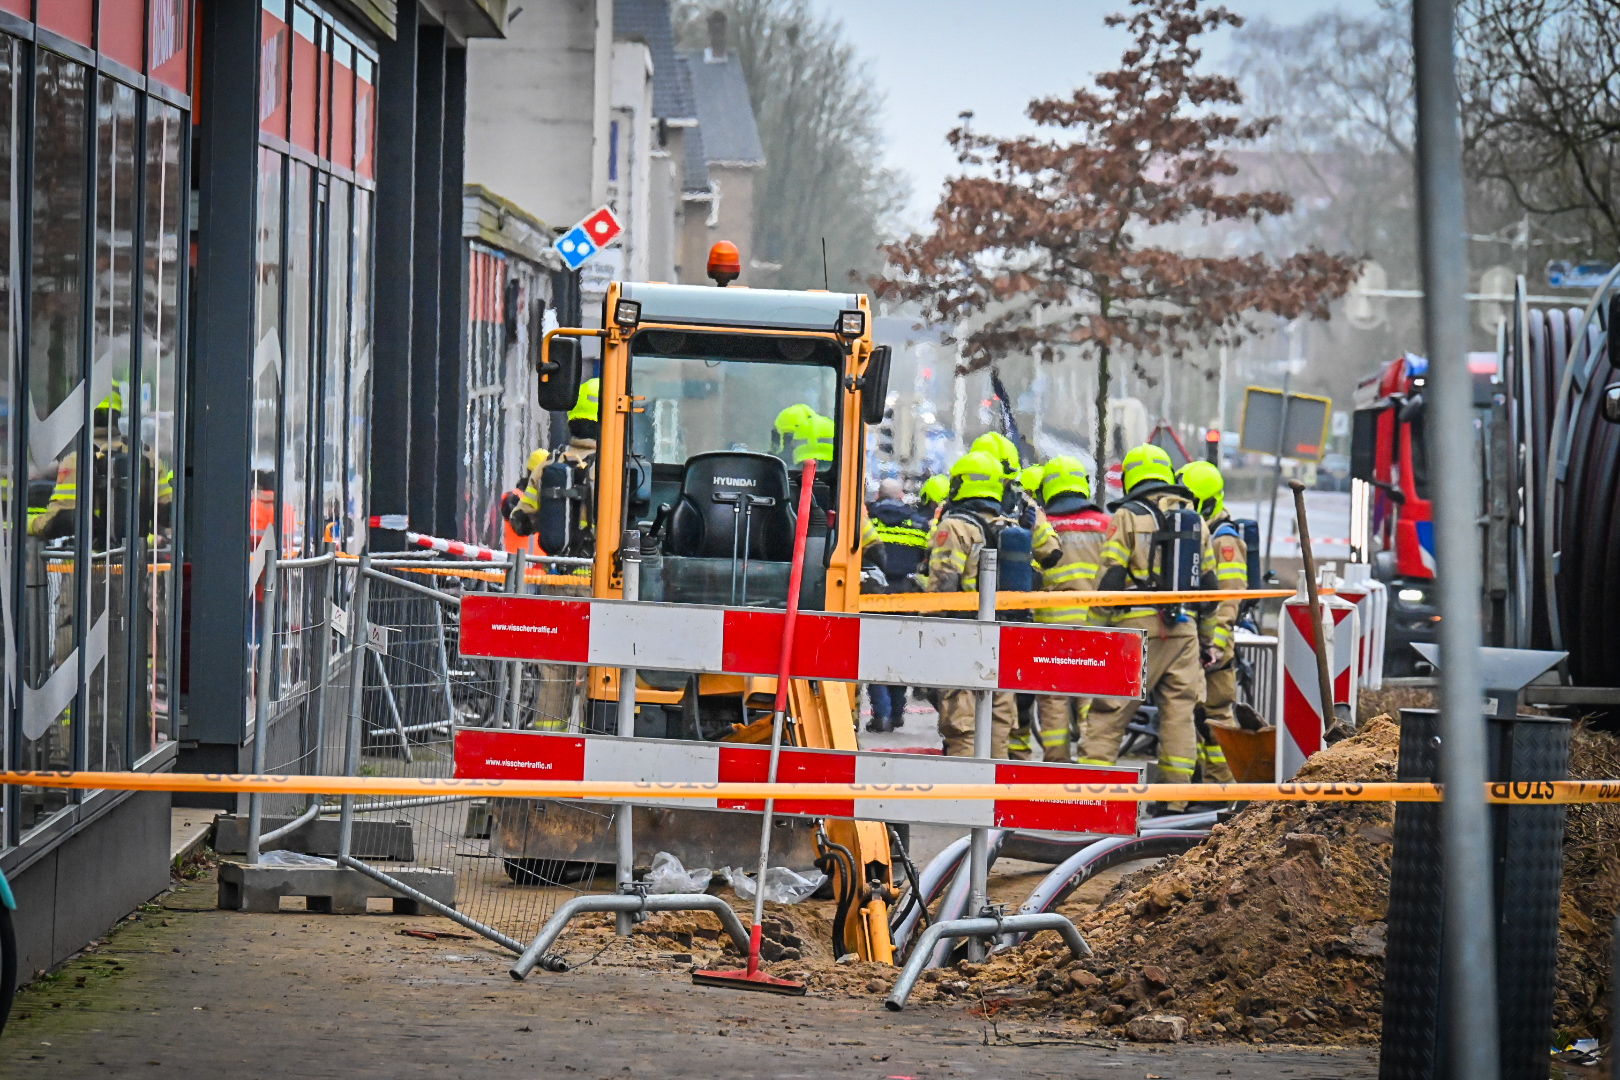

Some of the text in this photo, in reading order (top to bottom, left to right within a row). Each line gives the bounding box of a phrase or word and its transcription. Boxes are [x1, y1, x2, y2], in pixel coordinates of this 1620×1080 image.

[713, 476, 756, 487] HYUNDAI
[1033, 656, 1106, 667] www.visschertraffic.nl
[485, 758, 553, 770] www.visschertraffic.nl
